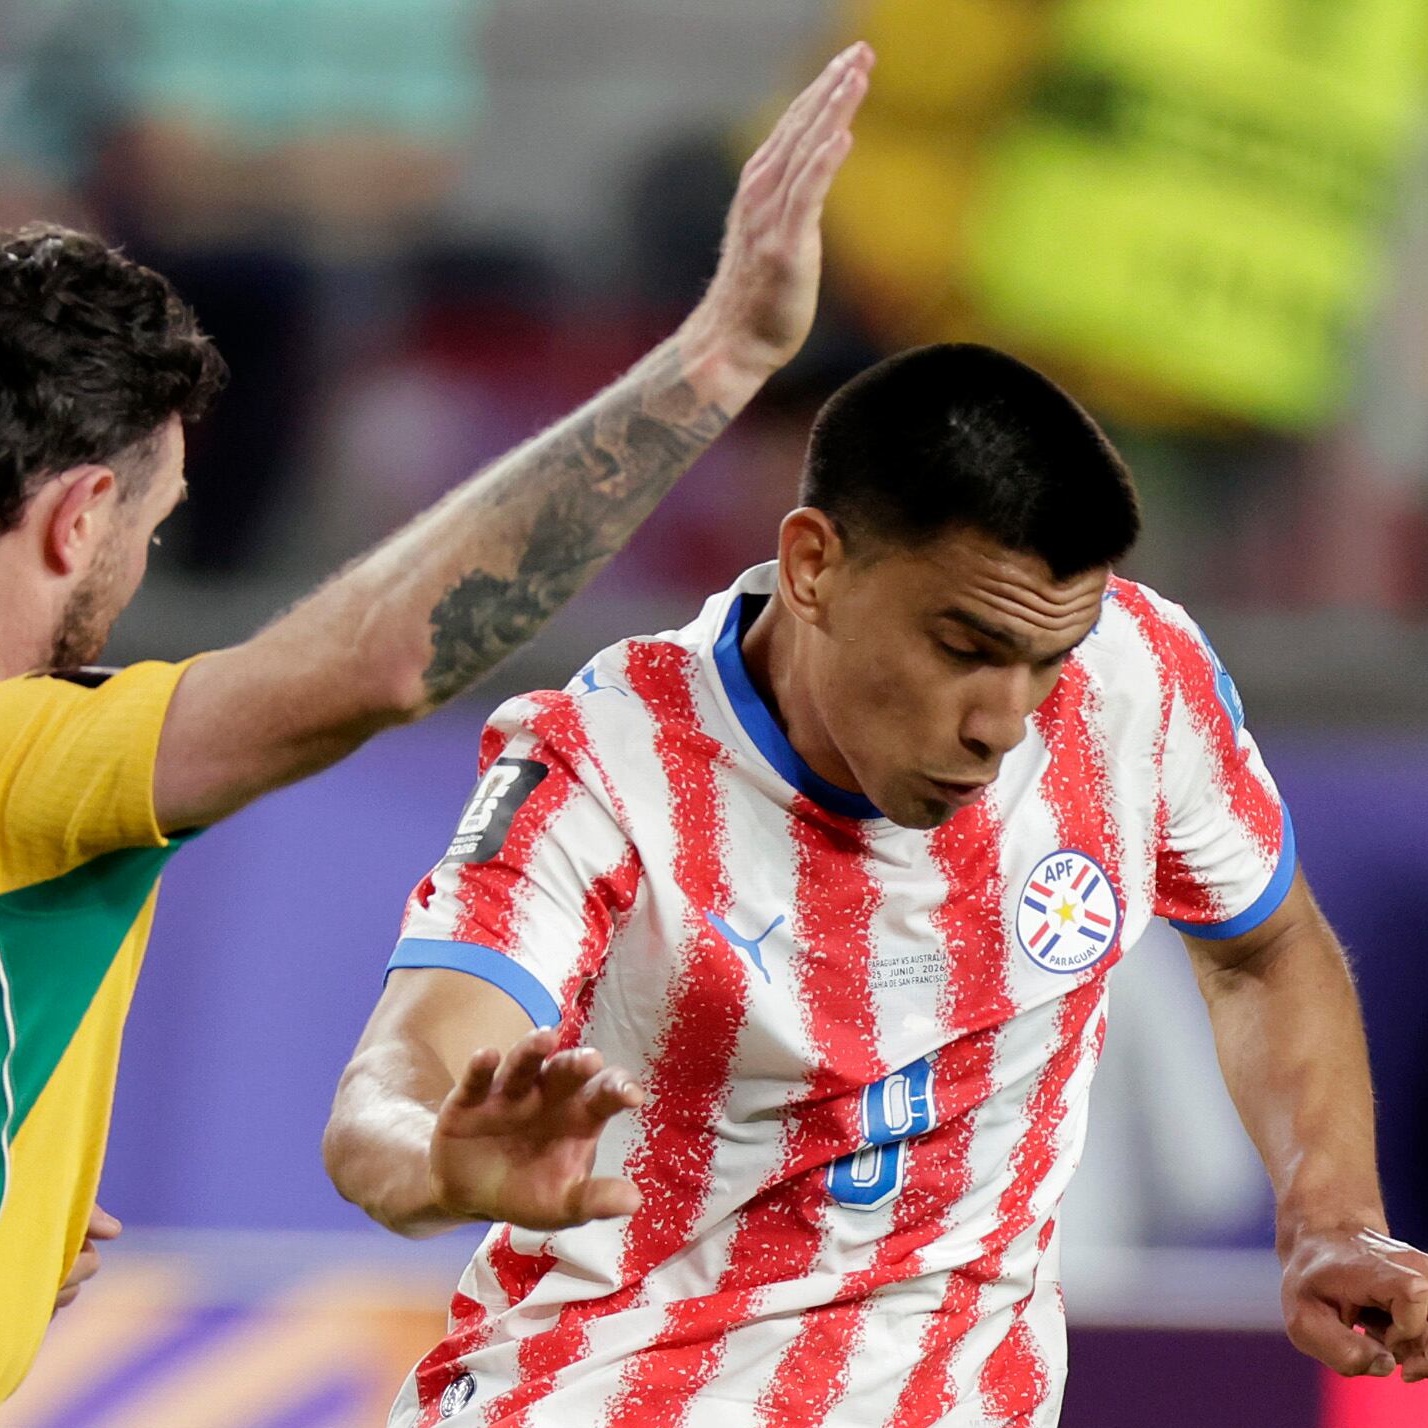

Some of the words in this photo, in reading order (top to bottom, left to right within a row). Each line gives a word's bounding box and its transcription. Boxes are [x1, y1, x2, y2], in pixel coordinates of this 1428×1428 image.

[1045, 859, 1073, 884] APF
[868, 959, 899, 968] PARAGUAY
[910, 953, 947, 963] AUSTRALIA
[1049, 944, 1098, 966] PARAGUAY
[872, 971, 882, 979] 25
[889, 966, 914, 977] JUNIO
[922, 964, 945, 974] 2026
[889, 979, 897, 988] DE
[898, 977, 911, 986] SAN
[912, 974, 948, 984] FRANCISCO
